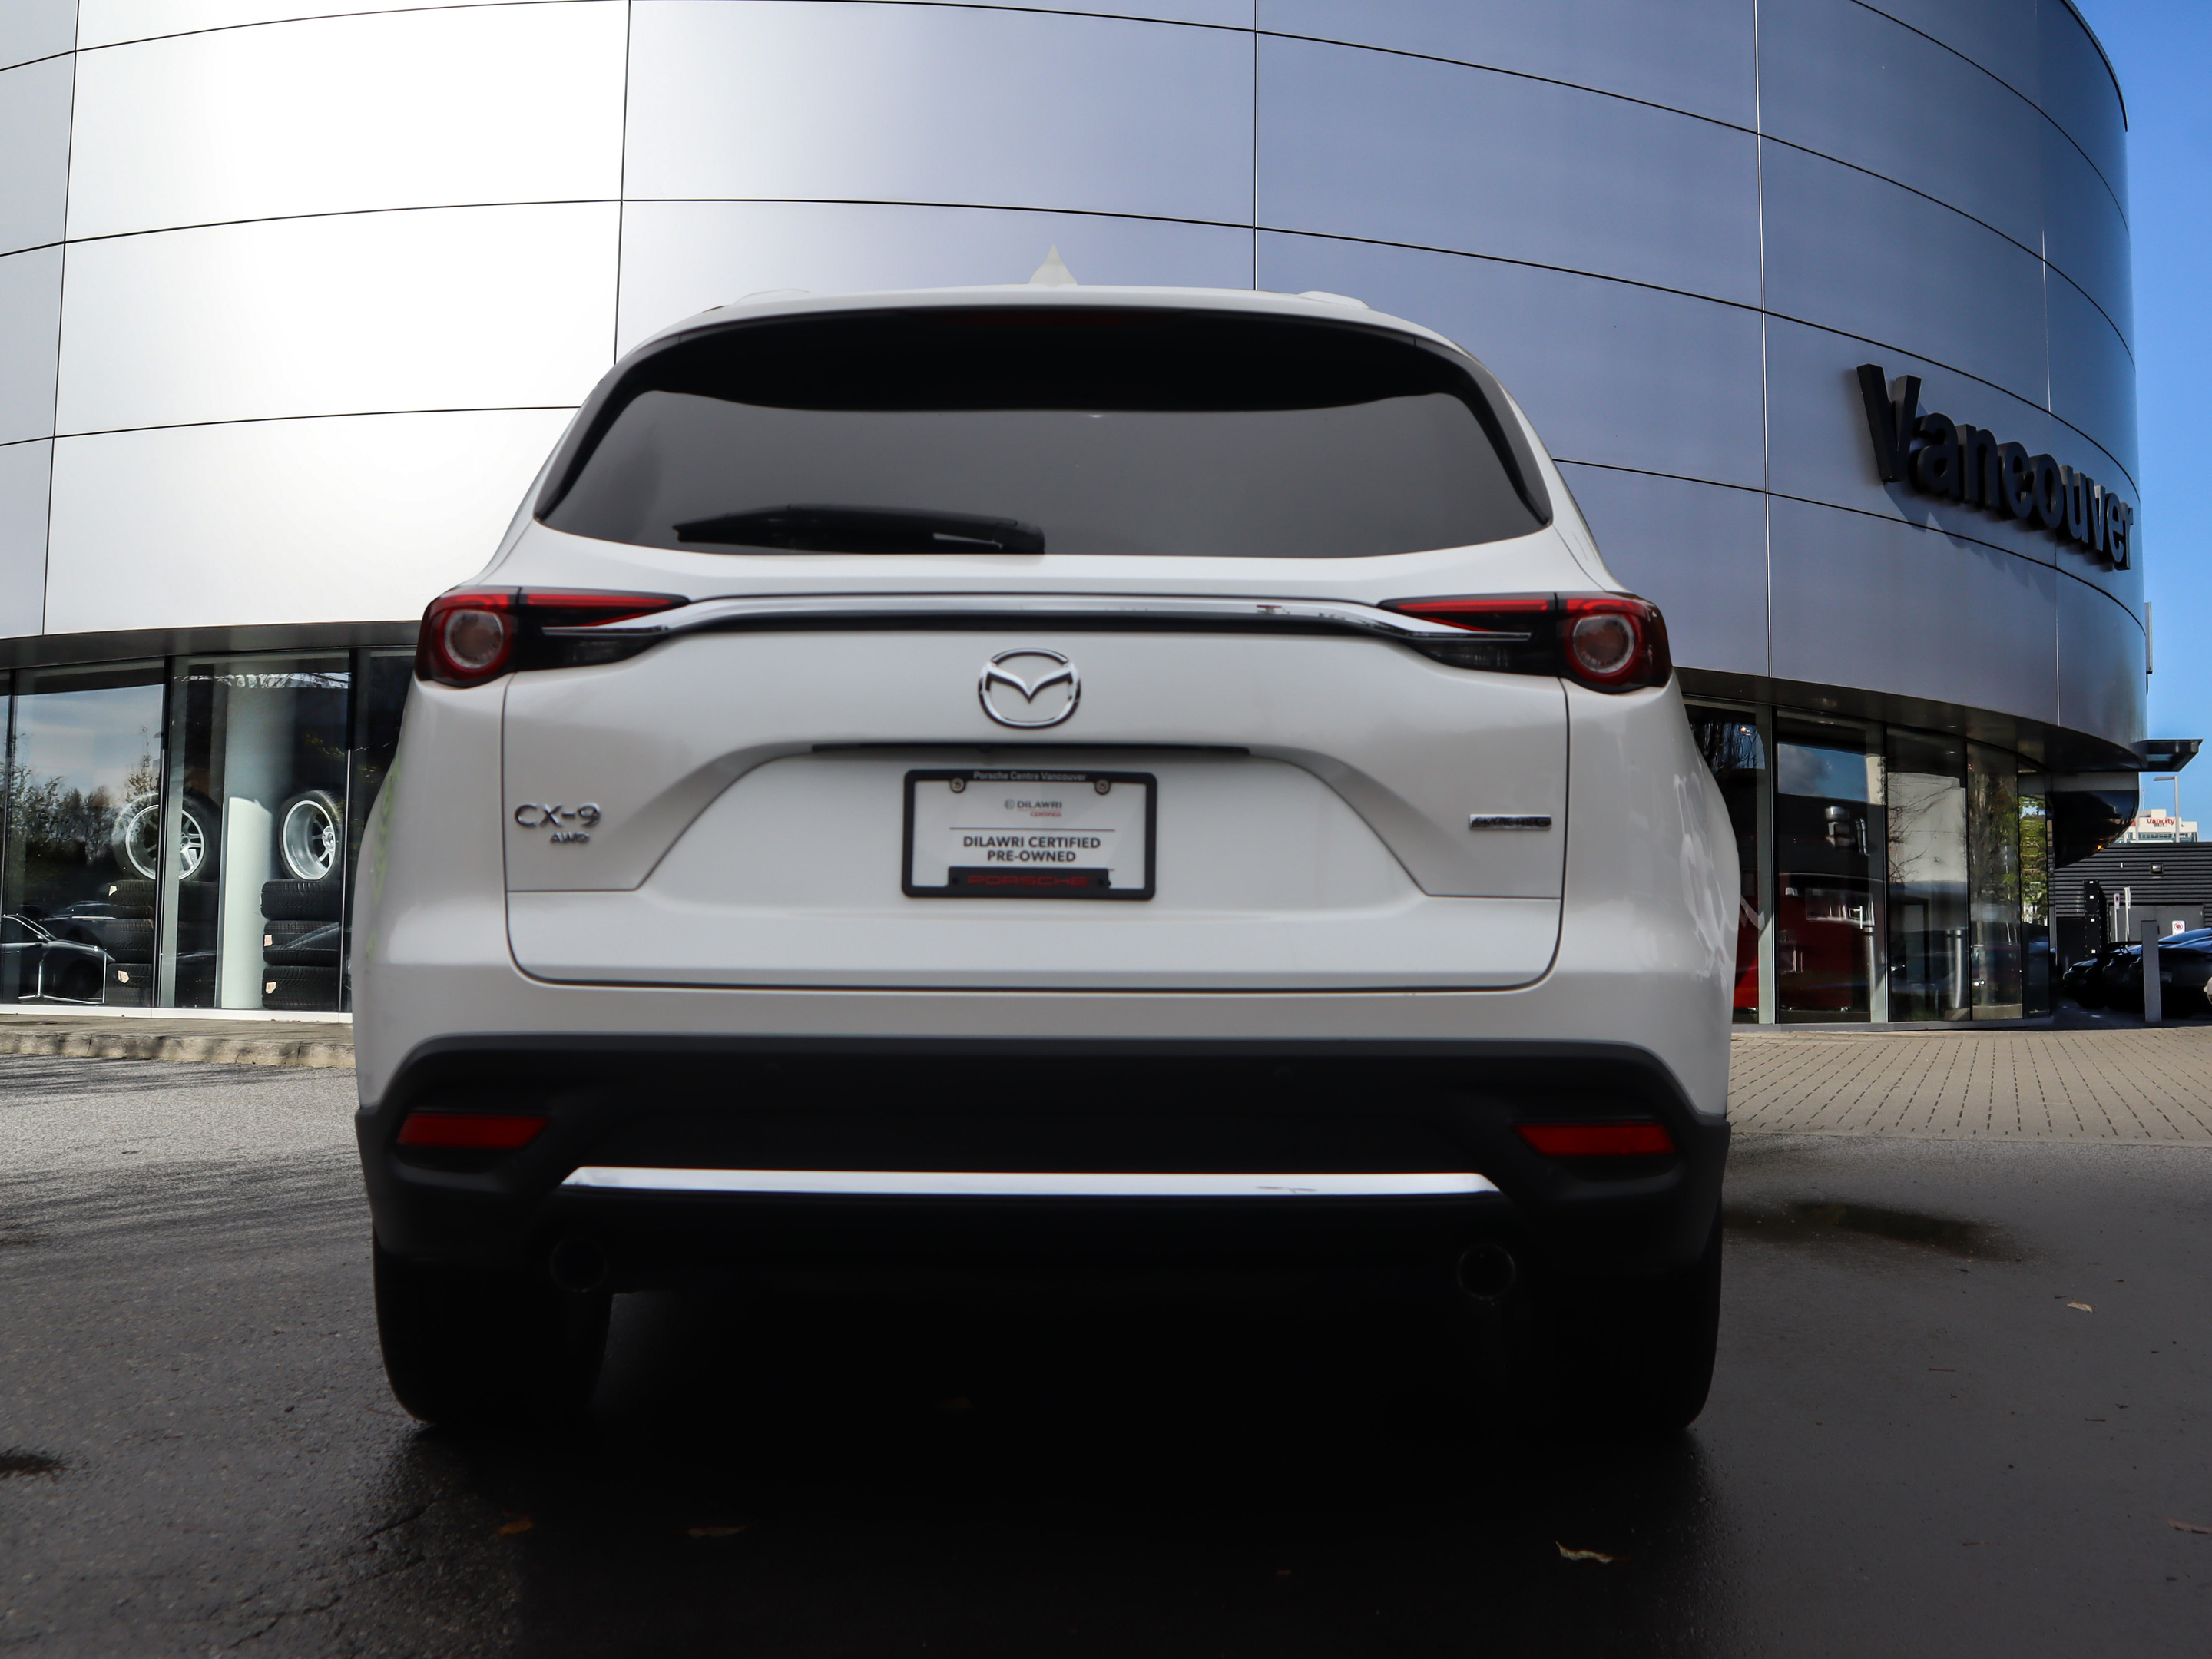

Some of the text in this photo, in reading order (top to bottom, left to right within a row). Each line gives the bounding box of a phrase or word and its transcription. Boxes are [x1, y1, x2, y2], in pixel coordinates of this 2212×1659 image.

[1856, 363, 2134, 571] Vancouver
[973, 771, 1086, 781] Porsche Centre Vancouver
[1017, 800, 1062, 809] DILAWRI
[515, 803, 601, 828] CX-9
[551, 832, 589, 843] AWD
[963, 836, 1101, 849] DILAWRI CERTIFIED
[988, 850, 1076, 862] PRE-OWNED
[968, 875, 1089, 887] PORSCHE
